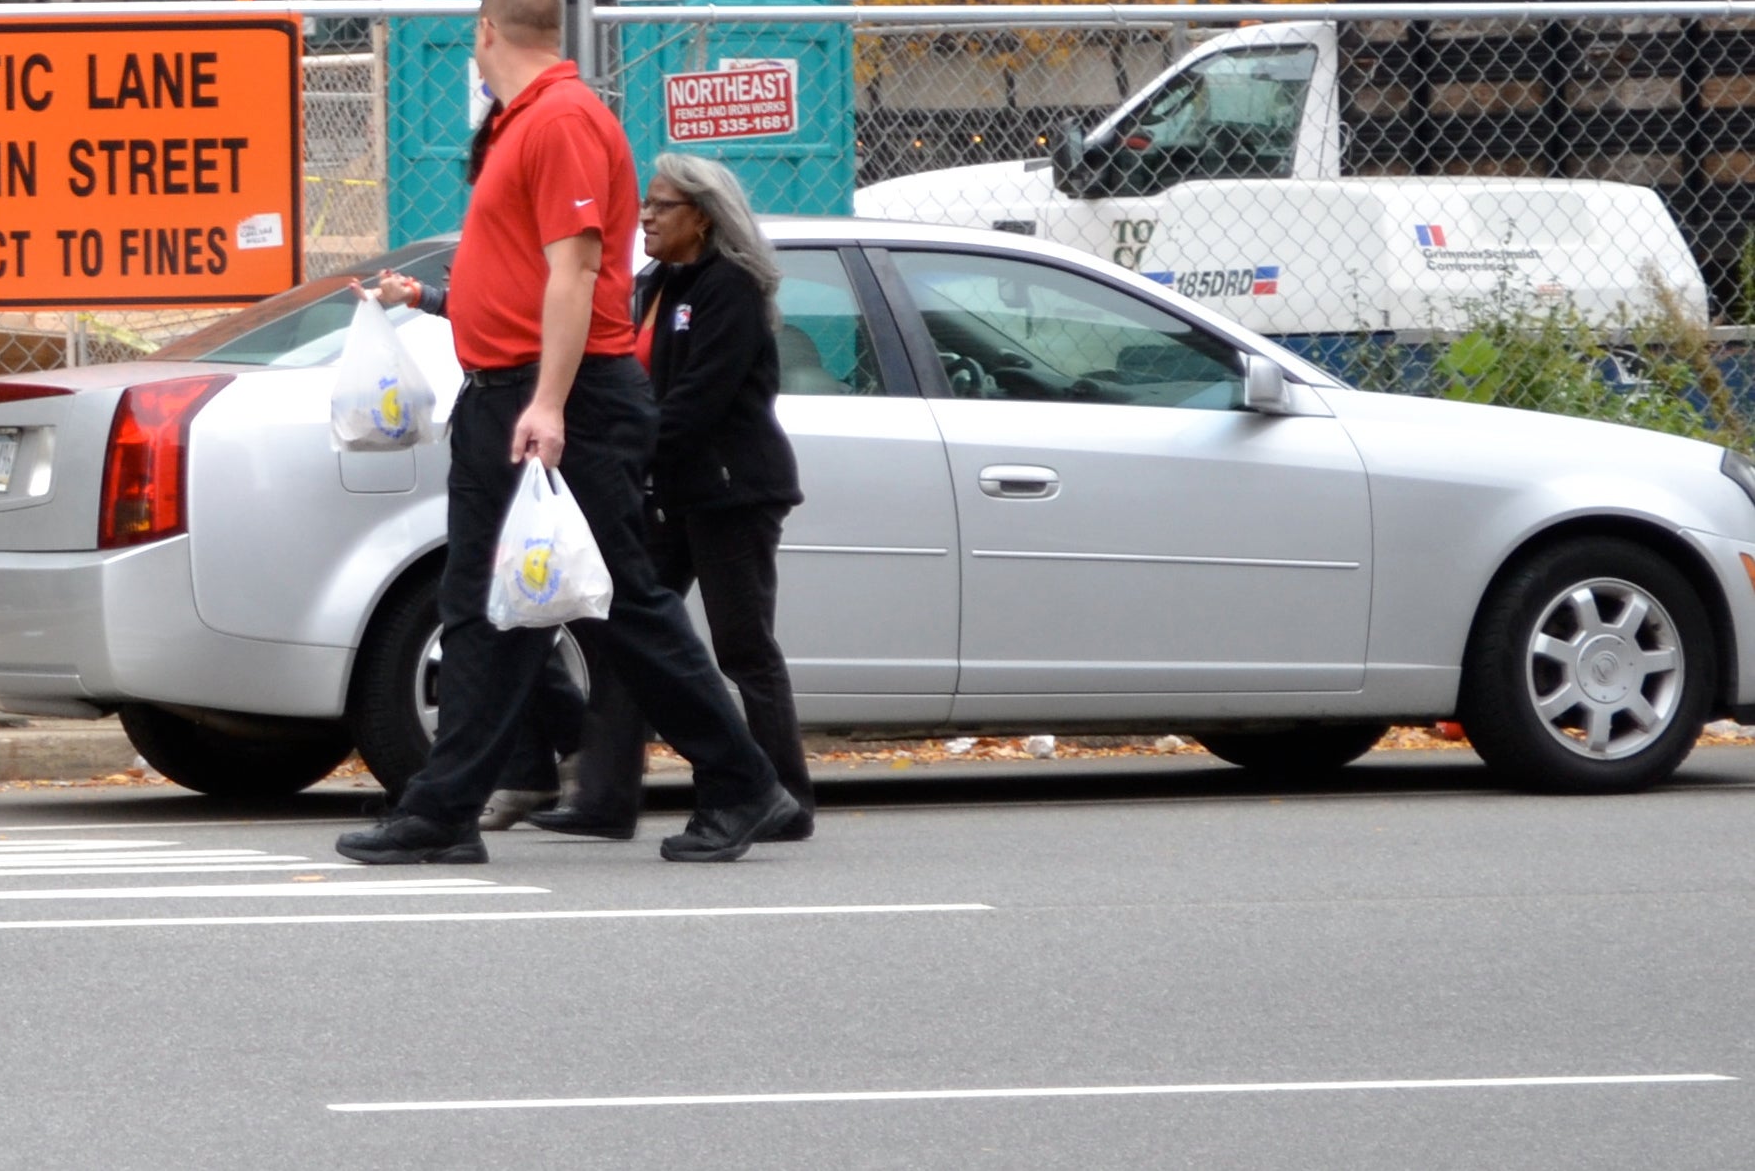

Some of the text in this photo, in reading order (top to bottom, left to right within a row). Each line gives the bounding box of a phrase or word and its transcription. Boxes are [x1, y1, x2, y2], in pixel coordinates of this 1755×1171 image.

[88, 52, 219, 109] LANE
[671, 73, 788, 106] NORTHEAST
[674, 115, 790, 137] (215) 335-1681
[675, 106, 705, 119] FENCE
[707, 105, 726, 117] AND
[68, 137, 249, 197] STREET
[56, 229, 103, 277] TO
[120, 226, 228, 276] FINES
[1176, 268, 1254, 298] 185DRD
